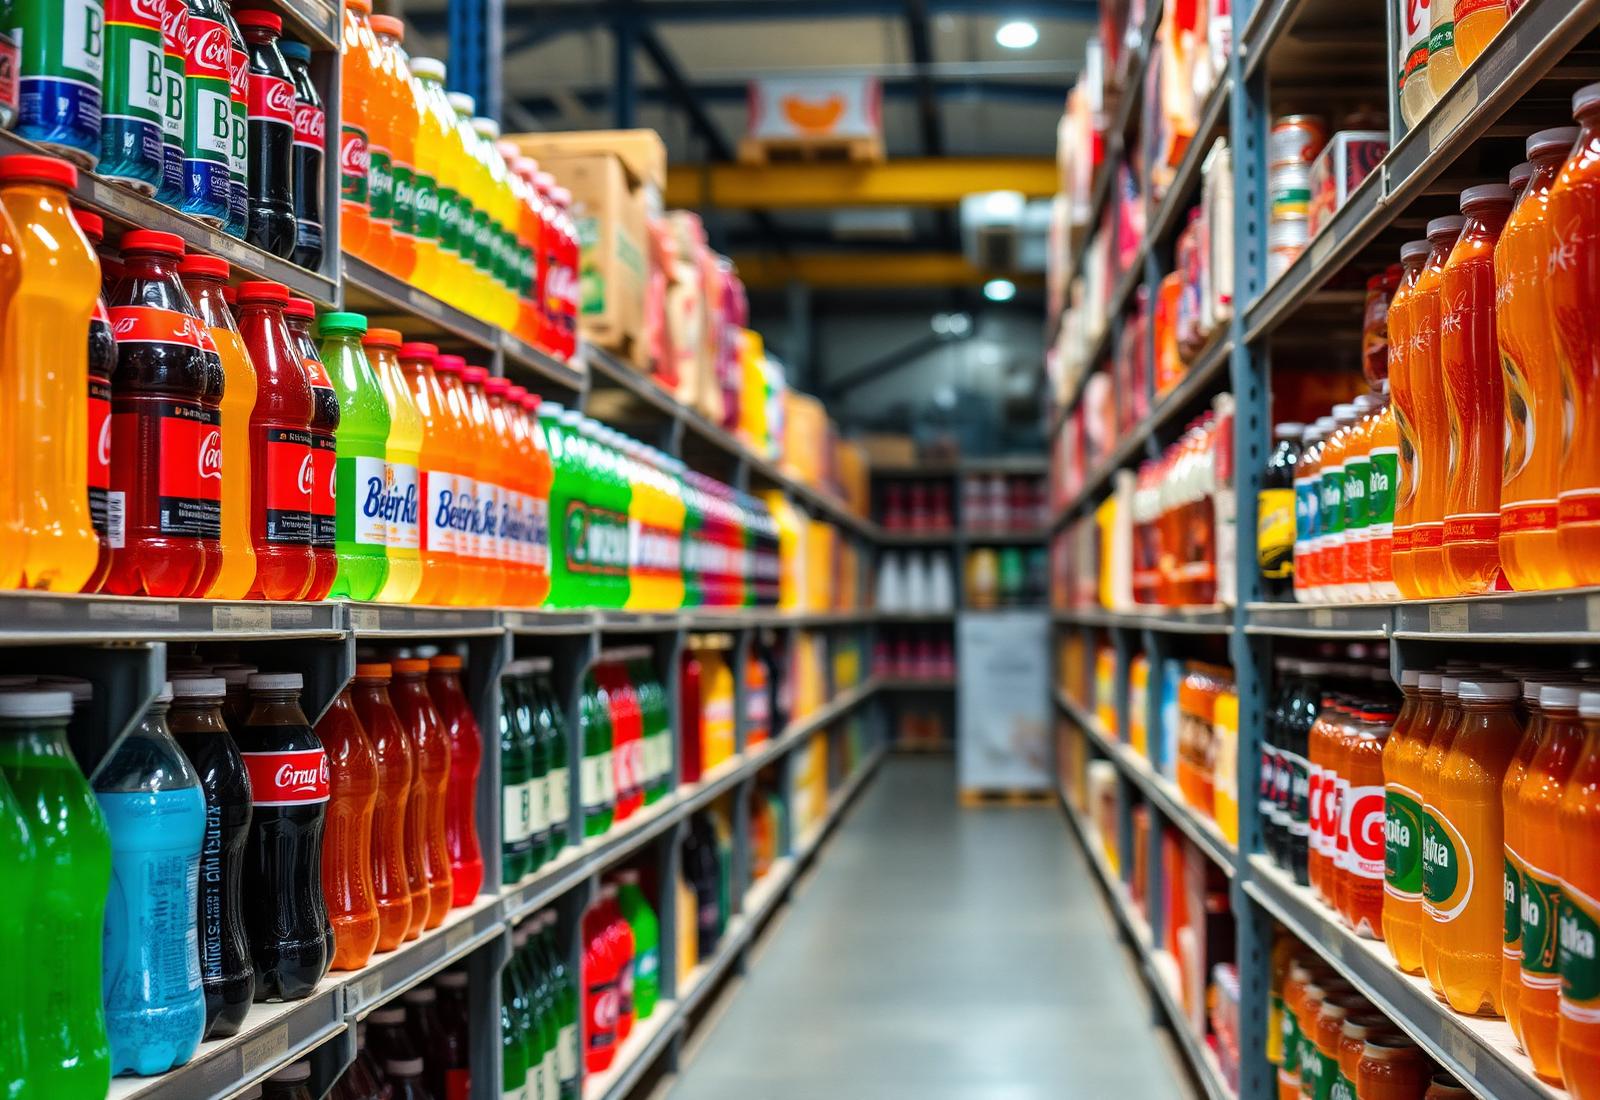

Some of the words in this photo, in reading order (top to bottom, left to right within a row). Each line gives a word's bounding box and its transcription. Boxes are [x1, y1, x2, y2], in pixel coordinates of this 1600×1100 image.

[84, 5, 101, 58] B
[147, 50, 163, 97] B
[165, 76, 182, 120] B
[213, 98, 229, 139] B
[232, 118, 246, 160] B
